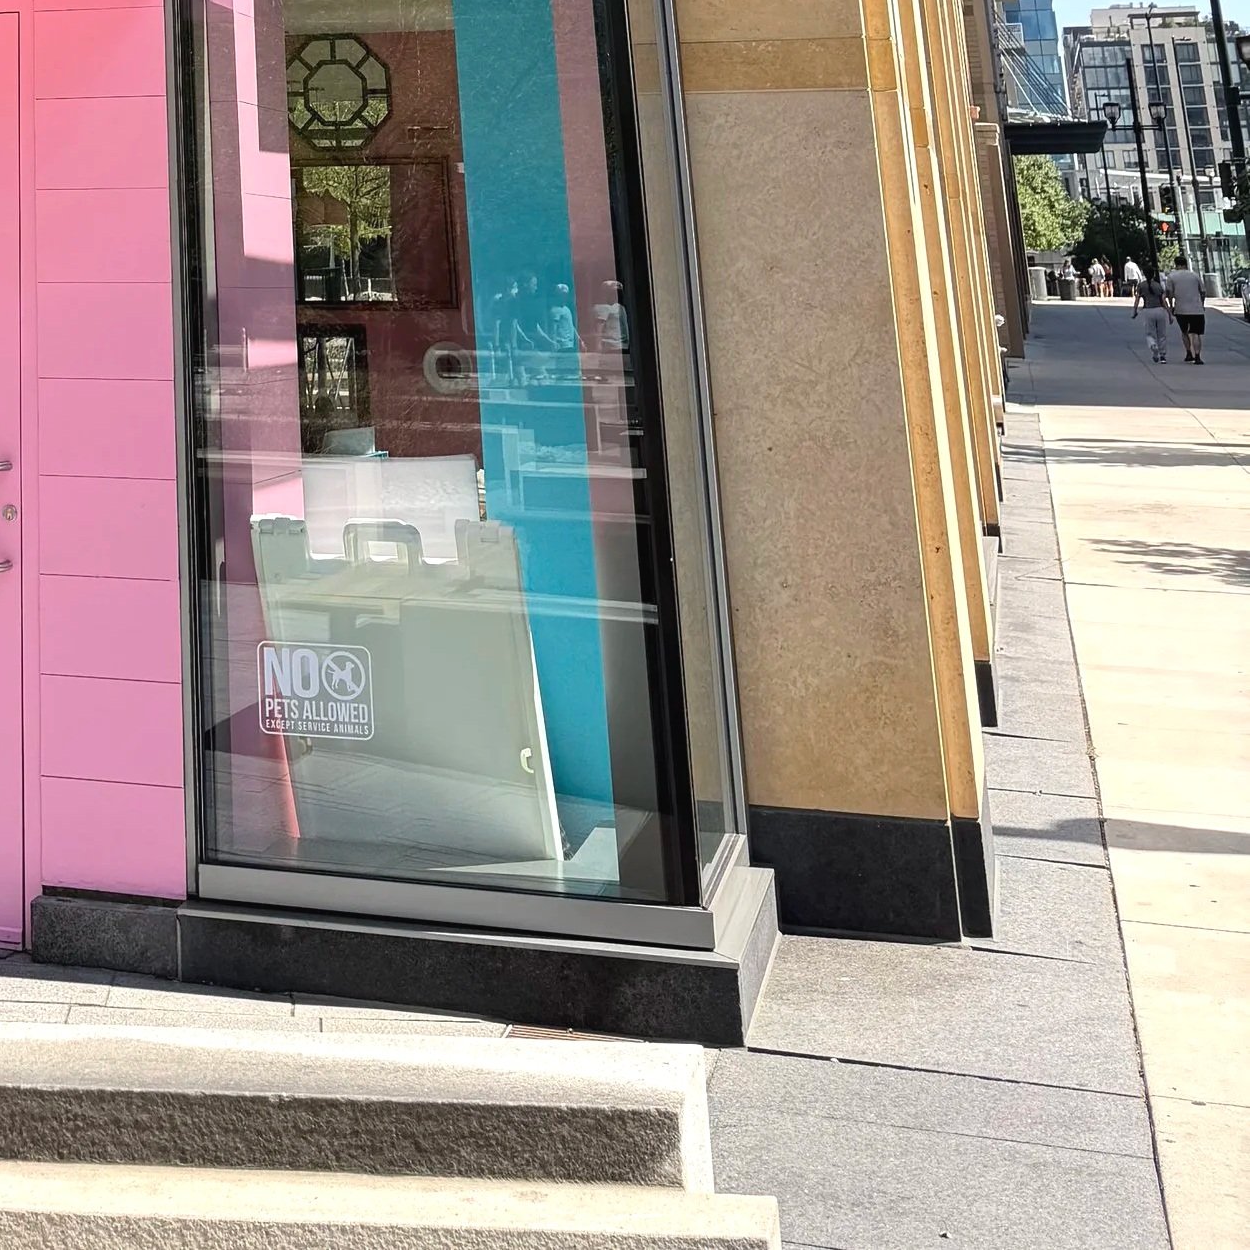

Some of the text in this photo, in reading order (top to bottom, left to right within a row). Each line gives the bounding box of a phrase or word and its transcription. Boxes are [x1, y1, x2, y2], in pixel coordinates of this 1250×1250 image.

[264, 647, 321, 699] NO
[265, 698, 369, 723] PETS ALLOWED
[266, 720, 370, 735] EXCEPT SERVICE ANIMALS
